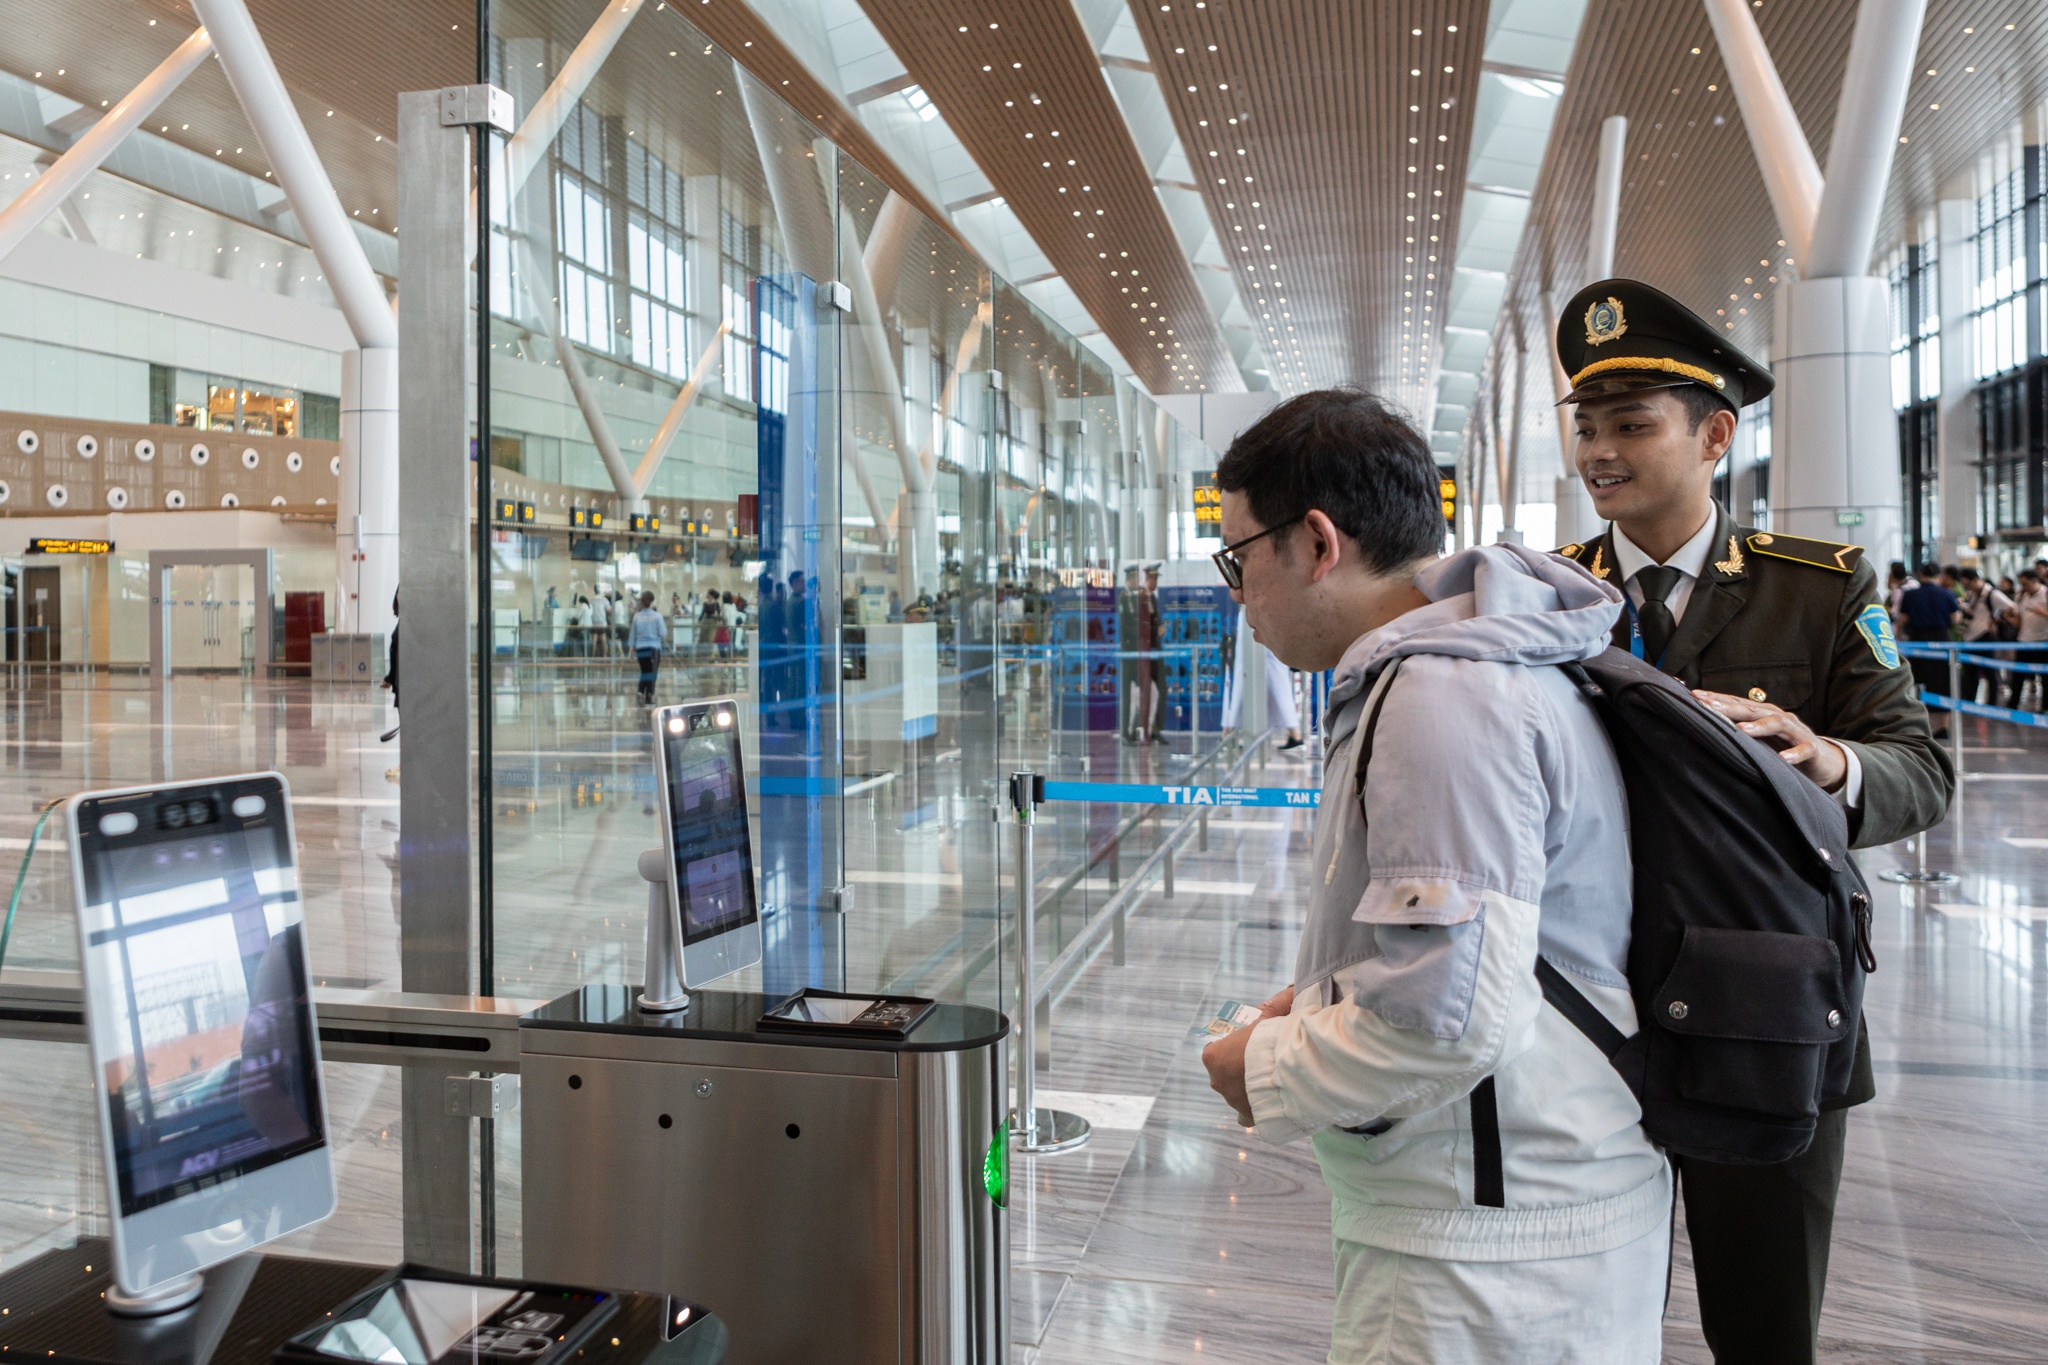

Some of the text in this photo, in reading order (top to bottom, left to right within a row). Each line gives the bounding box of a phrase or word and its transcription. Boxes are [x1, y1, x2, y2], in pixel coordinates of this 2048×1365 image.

[504, 504, 514, 517] 57
[1162, 786, 1213, 805] TIA
[1285, 792, 1310, 804] TAN
